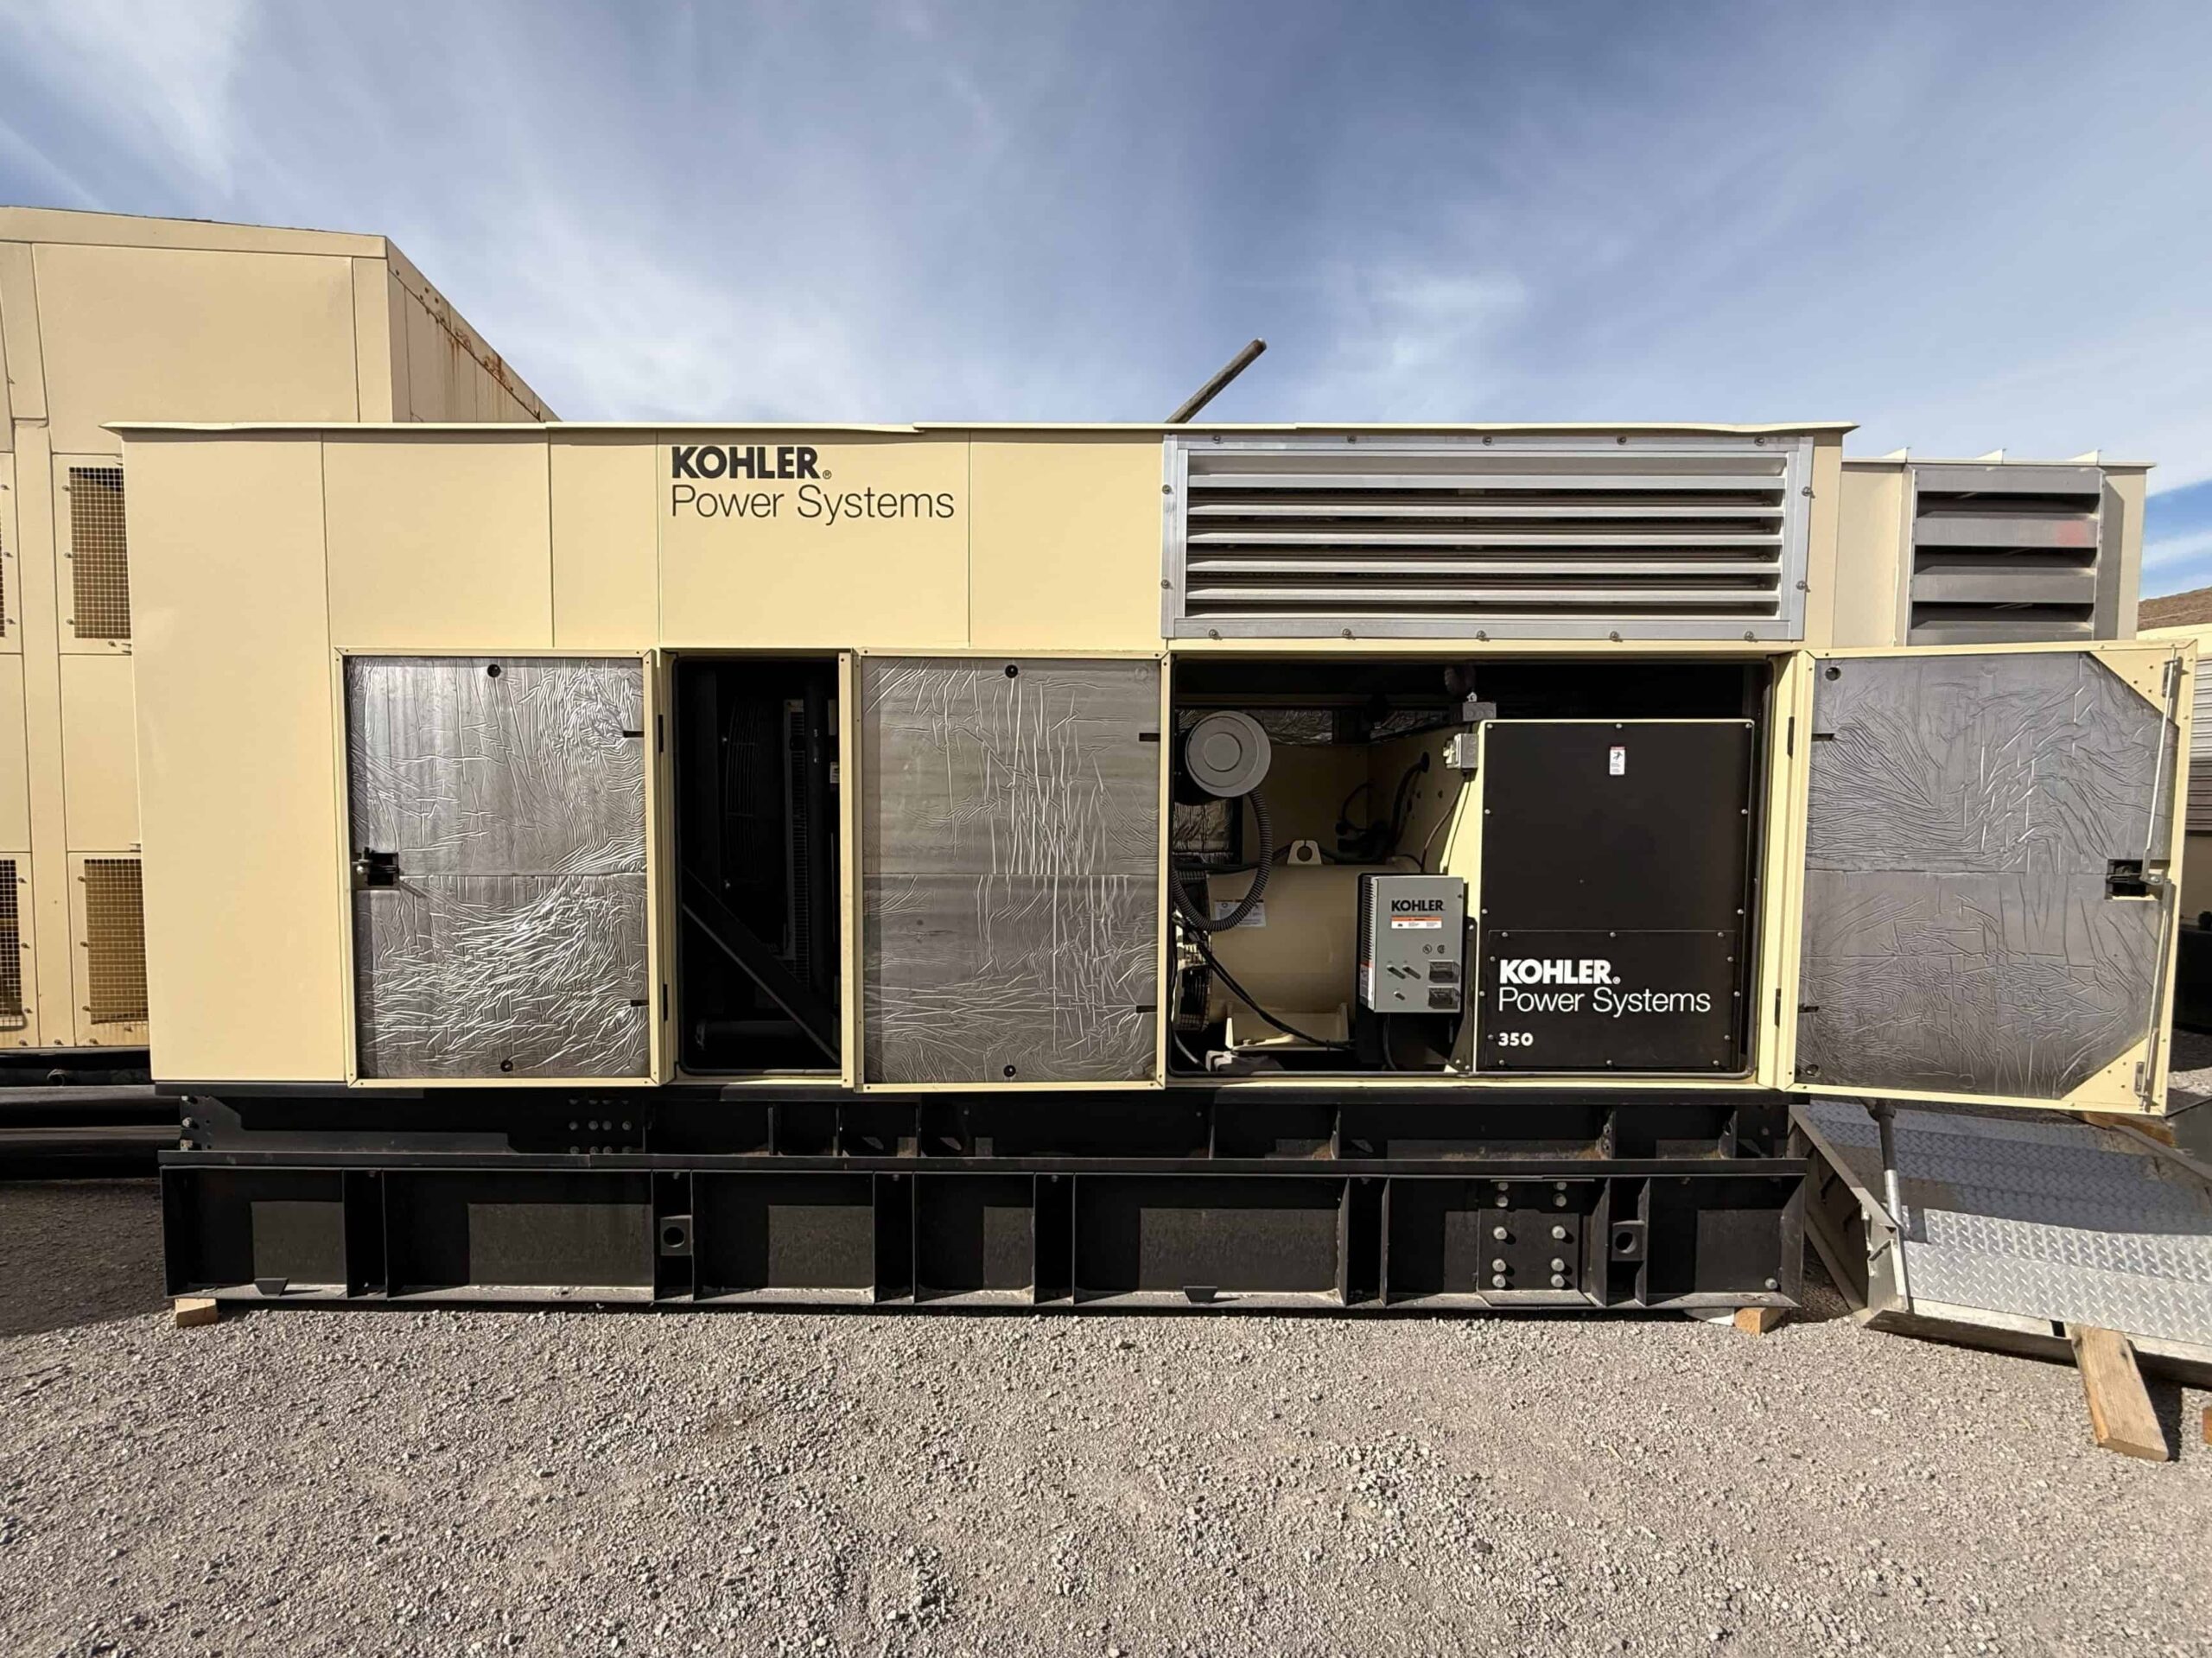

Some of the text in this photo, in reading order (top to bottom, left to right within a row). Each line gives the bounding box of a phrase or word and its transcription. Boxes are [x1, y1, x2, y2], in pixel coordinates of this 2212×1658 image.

[672, 484, 955, 526] Power Systems
[1391, 899, 1444, 912] KOHLER
[1498, 987, 1711, 1018] Power Systems
[1498, 1032, 1534, 1046] 350
